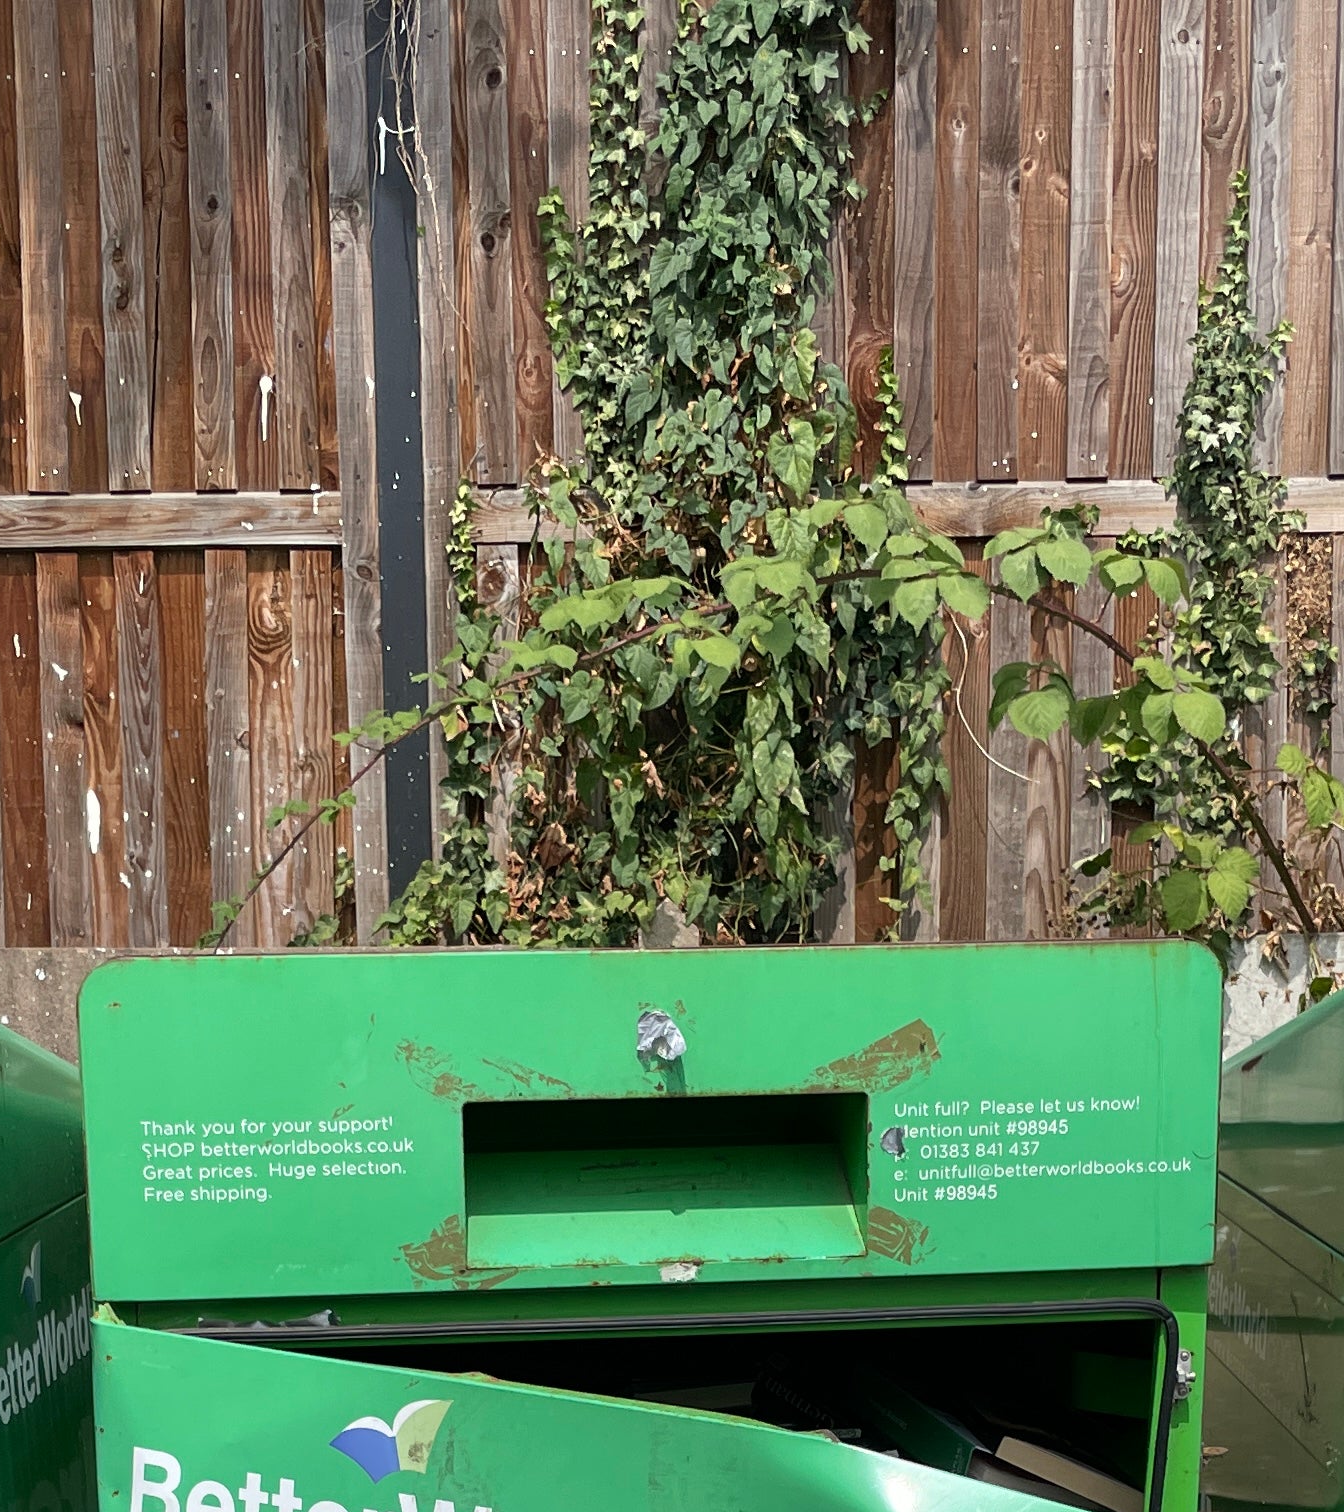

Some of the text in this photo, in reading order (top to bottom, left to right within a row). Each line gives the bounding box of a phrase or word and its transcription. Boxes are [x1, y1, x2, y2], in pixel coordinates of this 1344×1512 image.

[894, 1096, 1140, 1118] Unit full? Please let us know!
[140, 1116, 394, 1138] Thank you for your support!
[968, 1123, 1000, 1137] unit
[1006, 1120, 1069, 1136] #98945
[142, 1138, 414, 1159] SHOP betterworldbooks.co.uk
[920, 1142, 1040, 1159] 01383 841 437
[143, 1162, 407, 1181] Great prices. Huge selection.
[919, 1158, 1192, 1181] unitfull@betterworldbooks.co.uk
[144, 1185, 273, 1203] Free shipping.
[894, 1184, 998, 1203] Unit #98945
